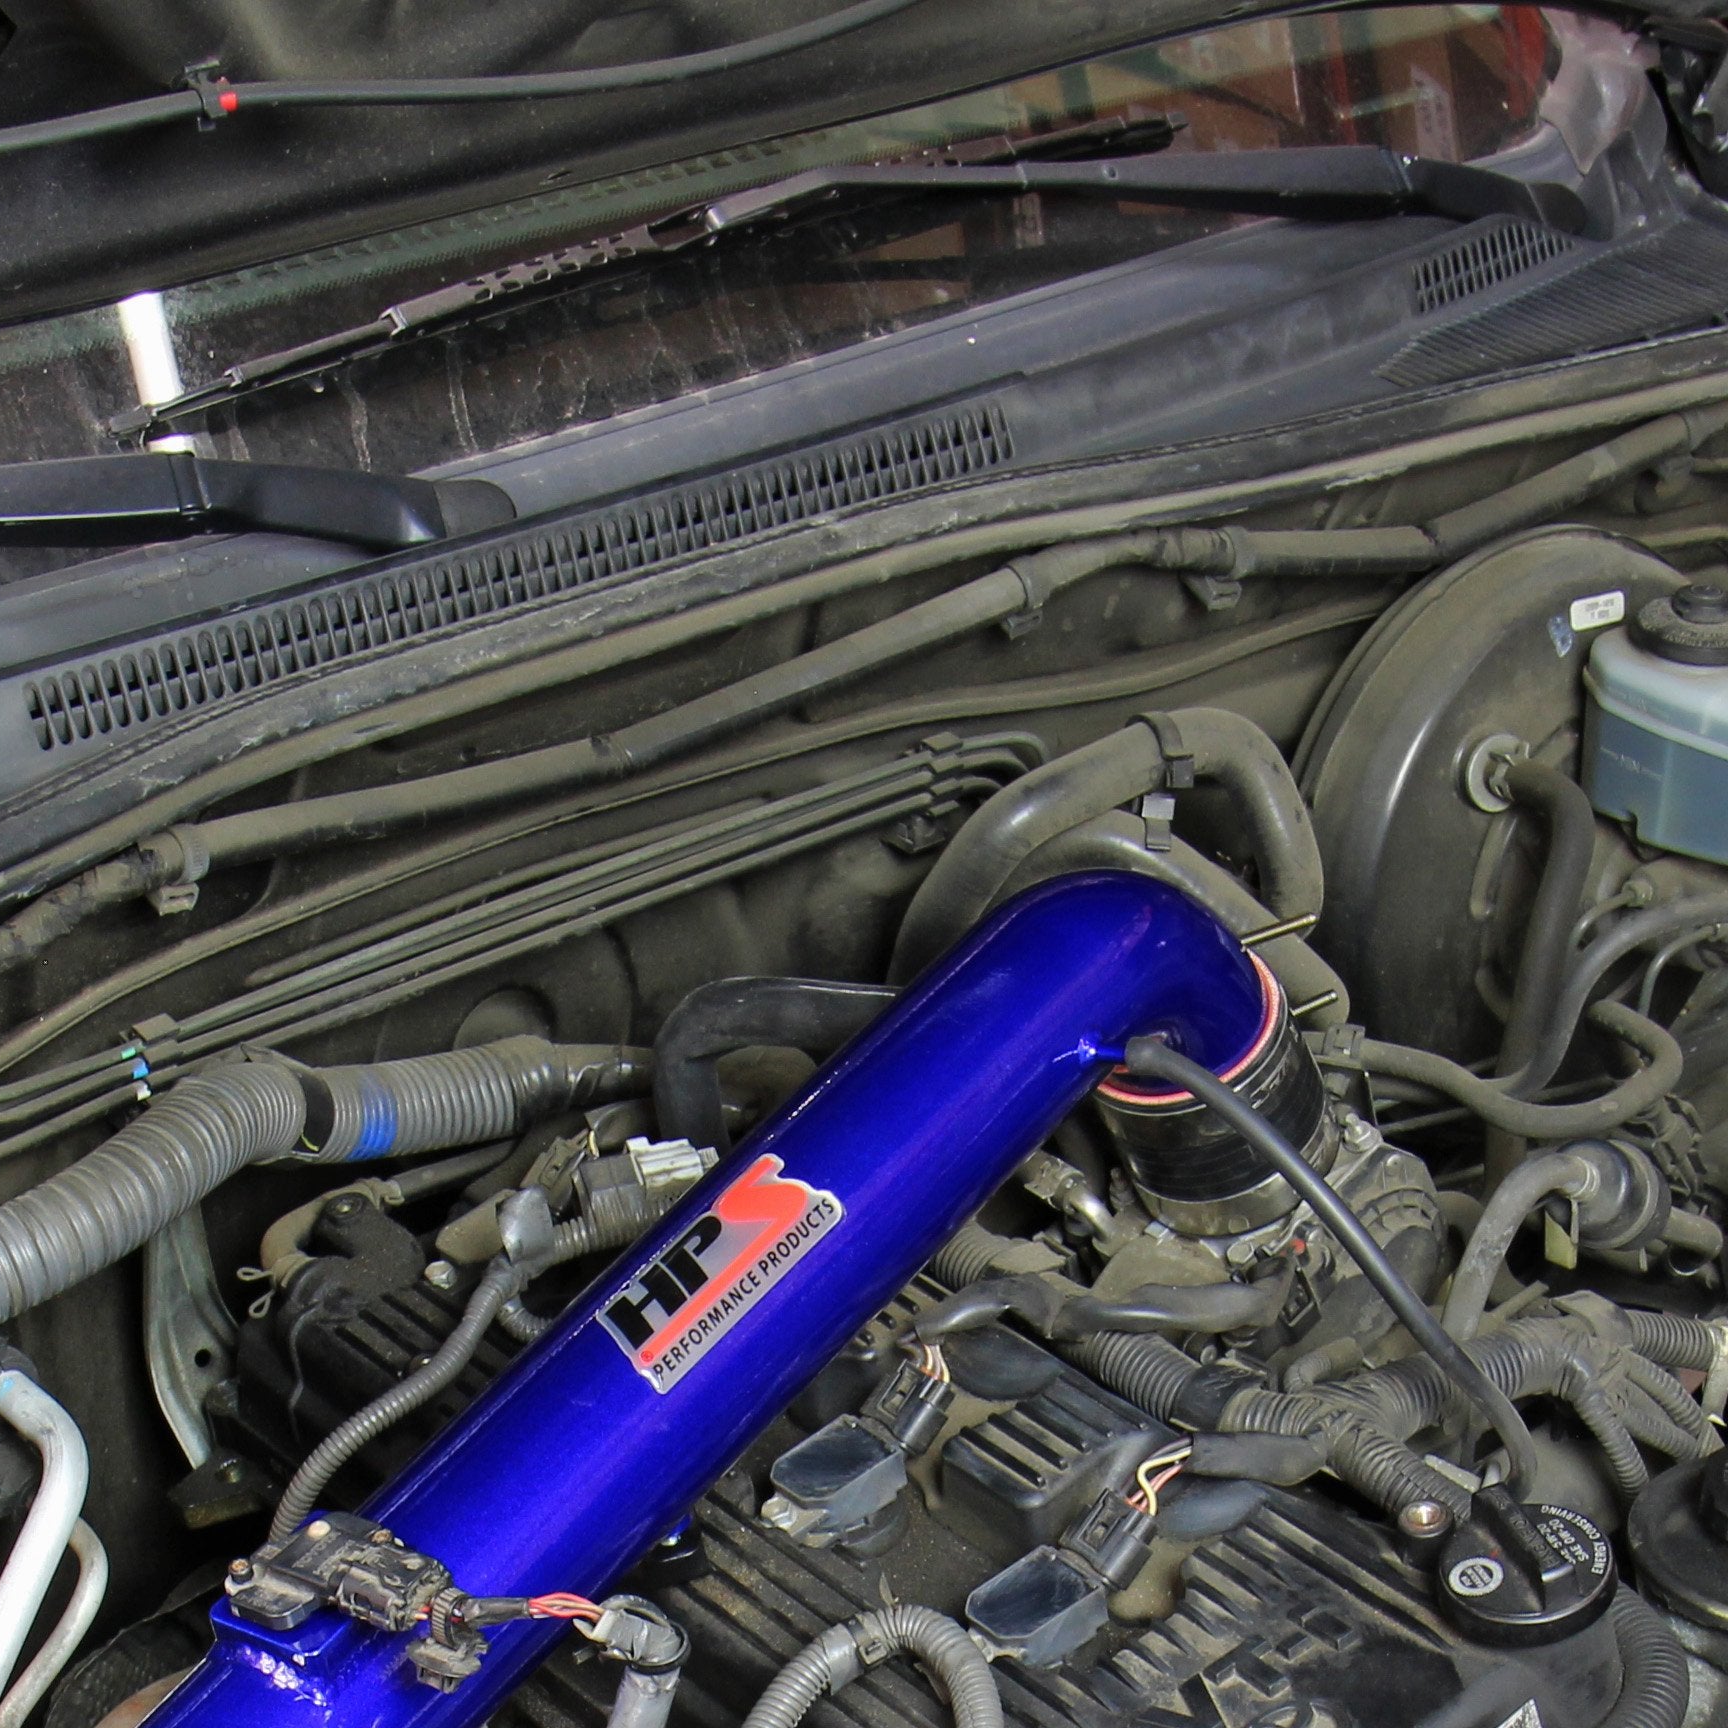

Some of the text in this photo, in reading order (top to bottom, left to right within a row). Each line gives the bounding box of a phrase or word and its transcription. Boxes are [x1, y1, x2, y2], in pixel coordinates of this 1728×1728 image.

[604, 1156, 808, 1366] HPS
[652, 1199, 835, 1378] PERFORMANCE PRODUCTS
[1541, 1504, 1607, 1575] ENERGY CONSERVING
[1570, 1545, 1590, 1562] SAE
